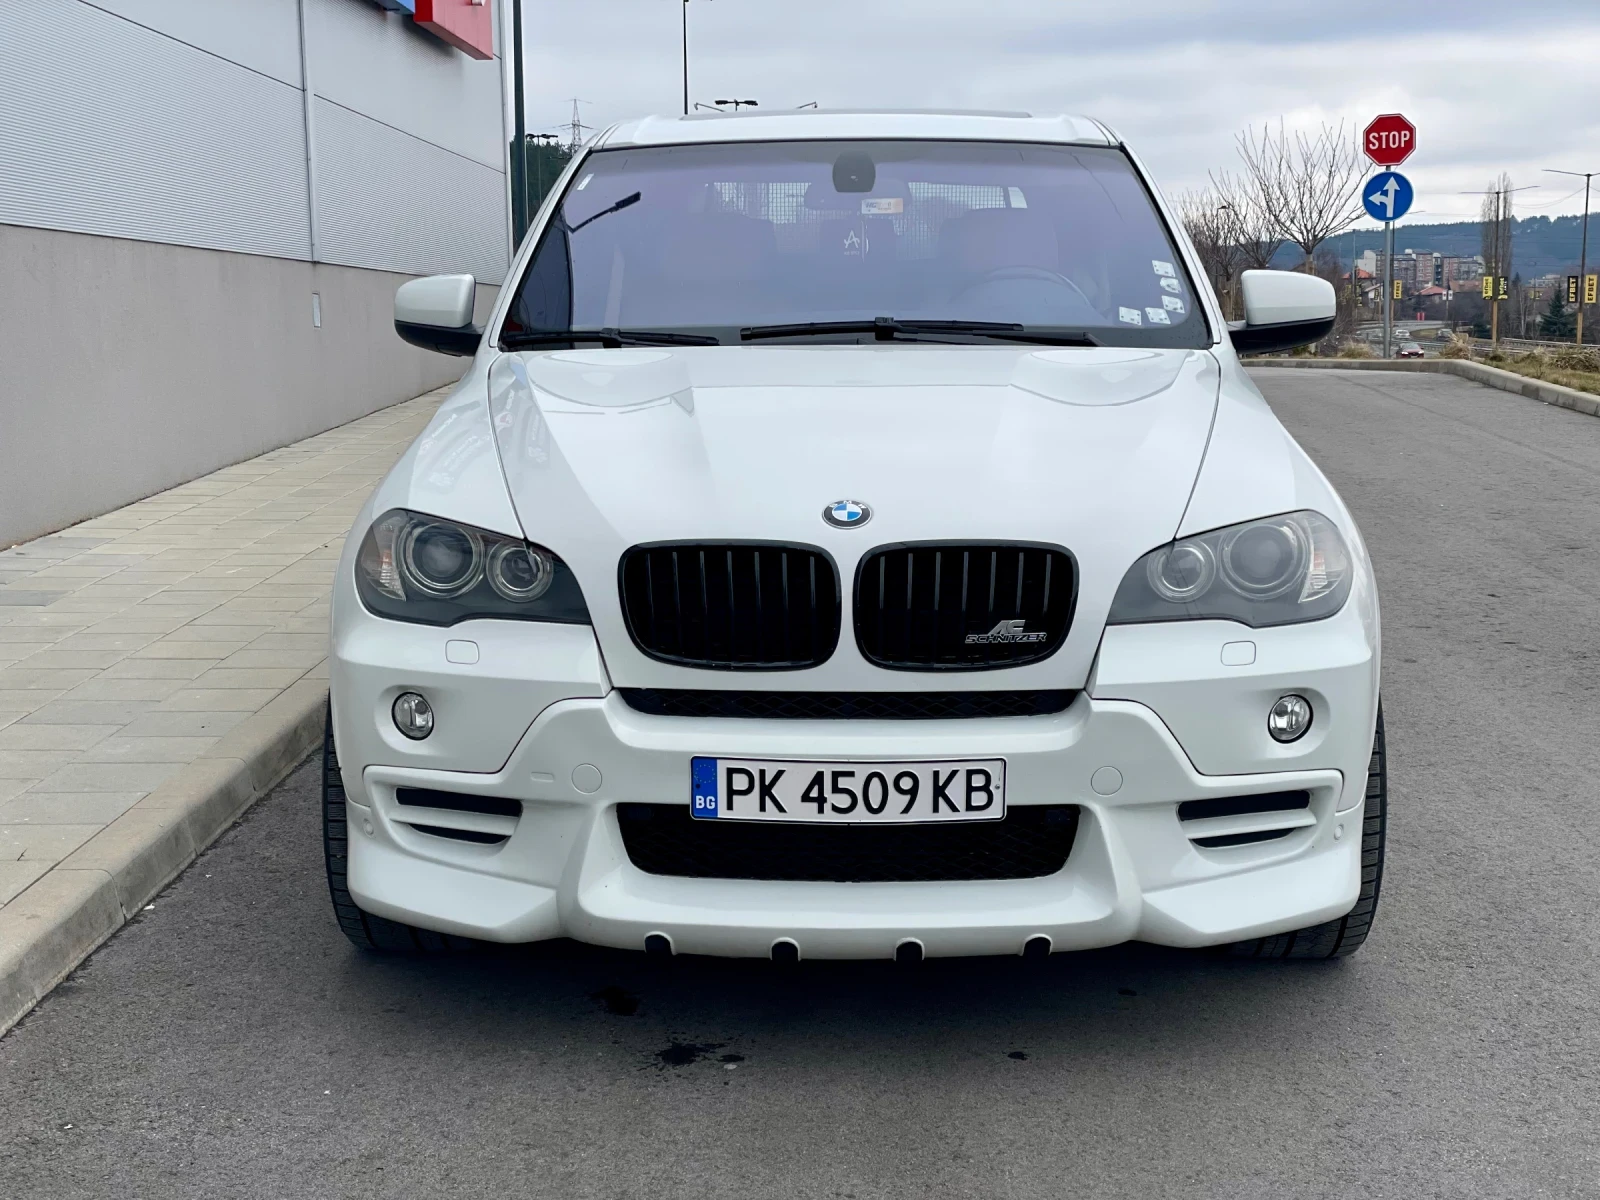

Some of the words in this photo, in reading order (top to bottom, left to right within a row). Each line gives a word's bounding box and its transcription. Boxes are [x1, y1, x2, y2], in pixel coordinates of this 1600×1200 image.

[1368, 131, 1410, 150] STOP
[988, 620, 1025, 634] AC
[965, 633, 1047, 643] SCHNITZER
[726, 767, 788, 813] PK
[801, 770, 920, 815] 4509
[931, 767, 995, 813] KB
[695, 795, 716, 809] BG
